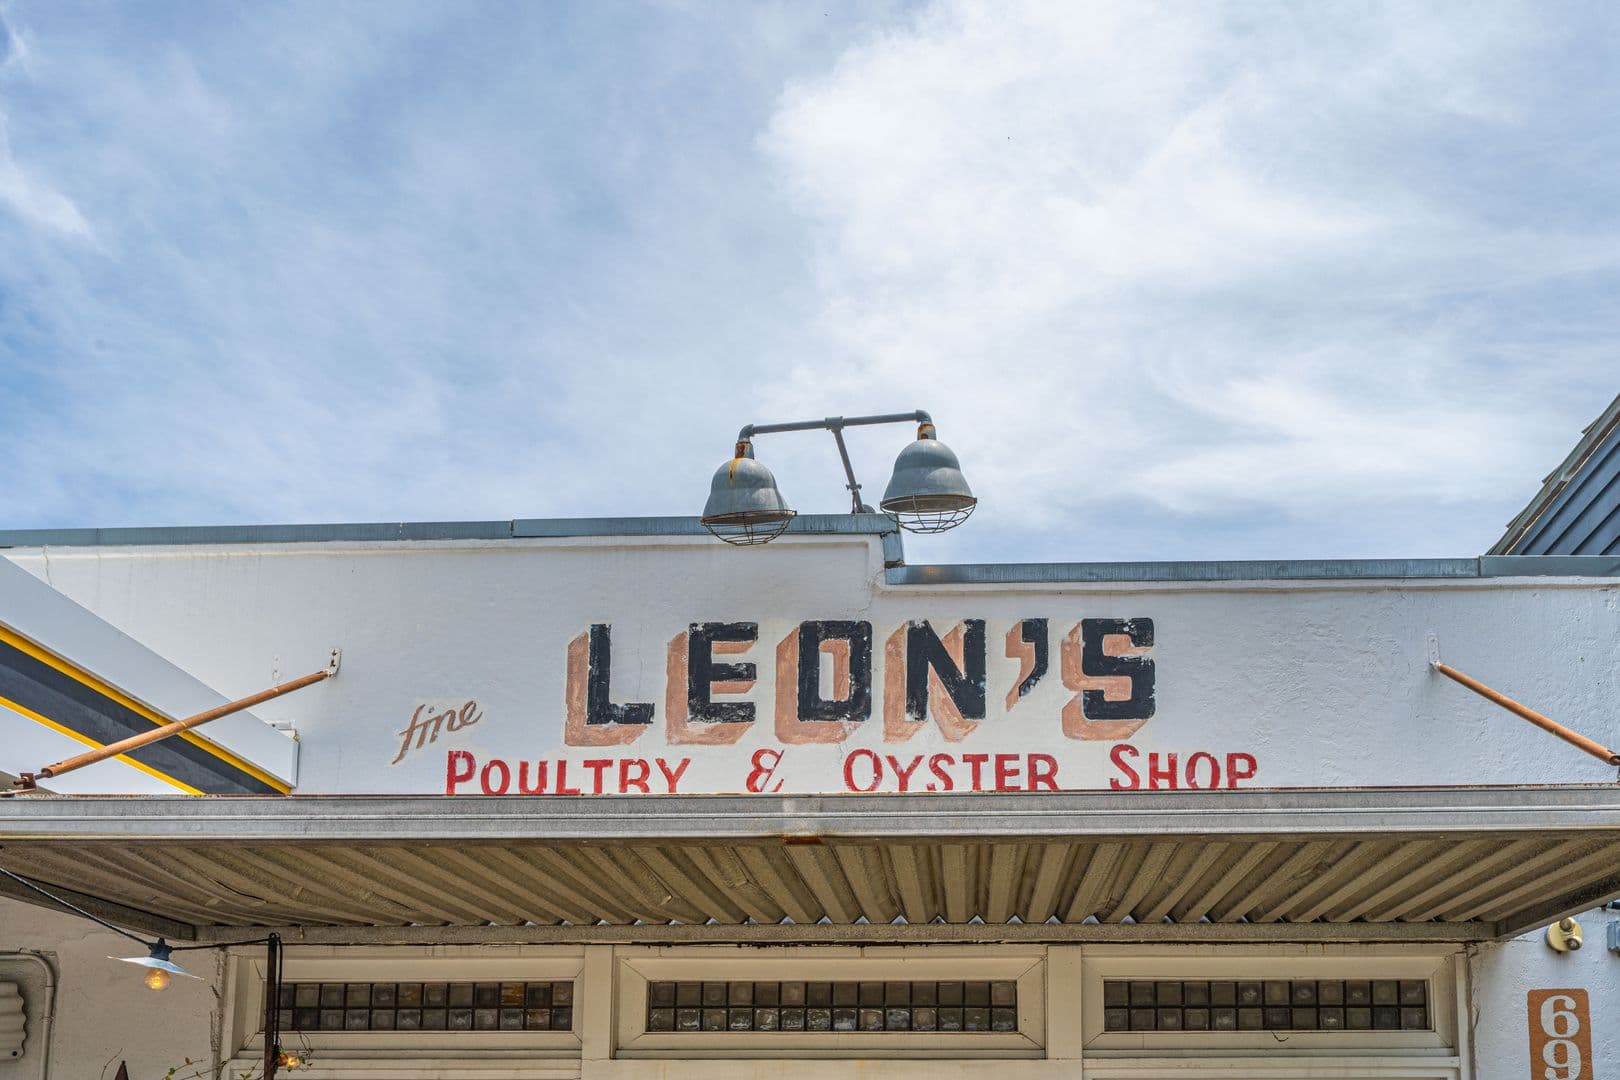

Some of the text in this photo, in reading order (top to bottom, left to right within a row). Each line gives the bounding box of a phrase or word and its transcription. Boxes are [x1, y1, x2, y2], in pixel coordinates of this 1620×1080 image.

[565, 617, 1156, 745] LEON'S
[391, 699, 484, 765] fine
[446, 743, 1258, 796] POULTRY & OYSTER SHOP
